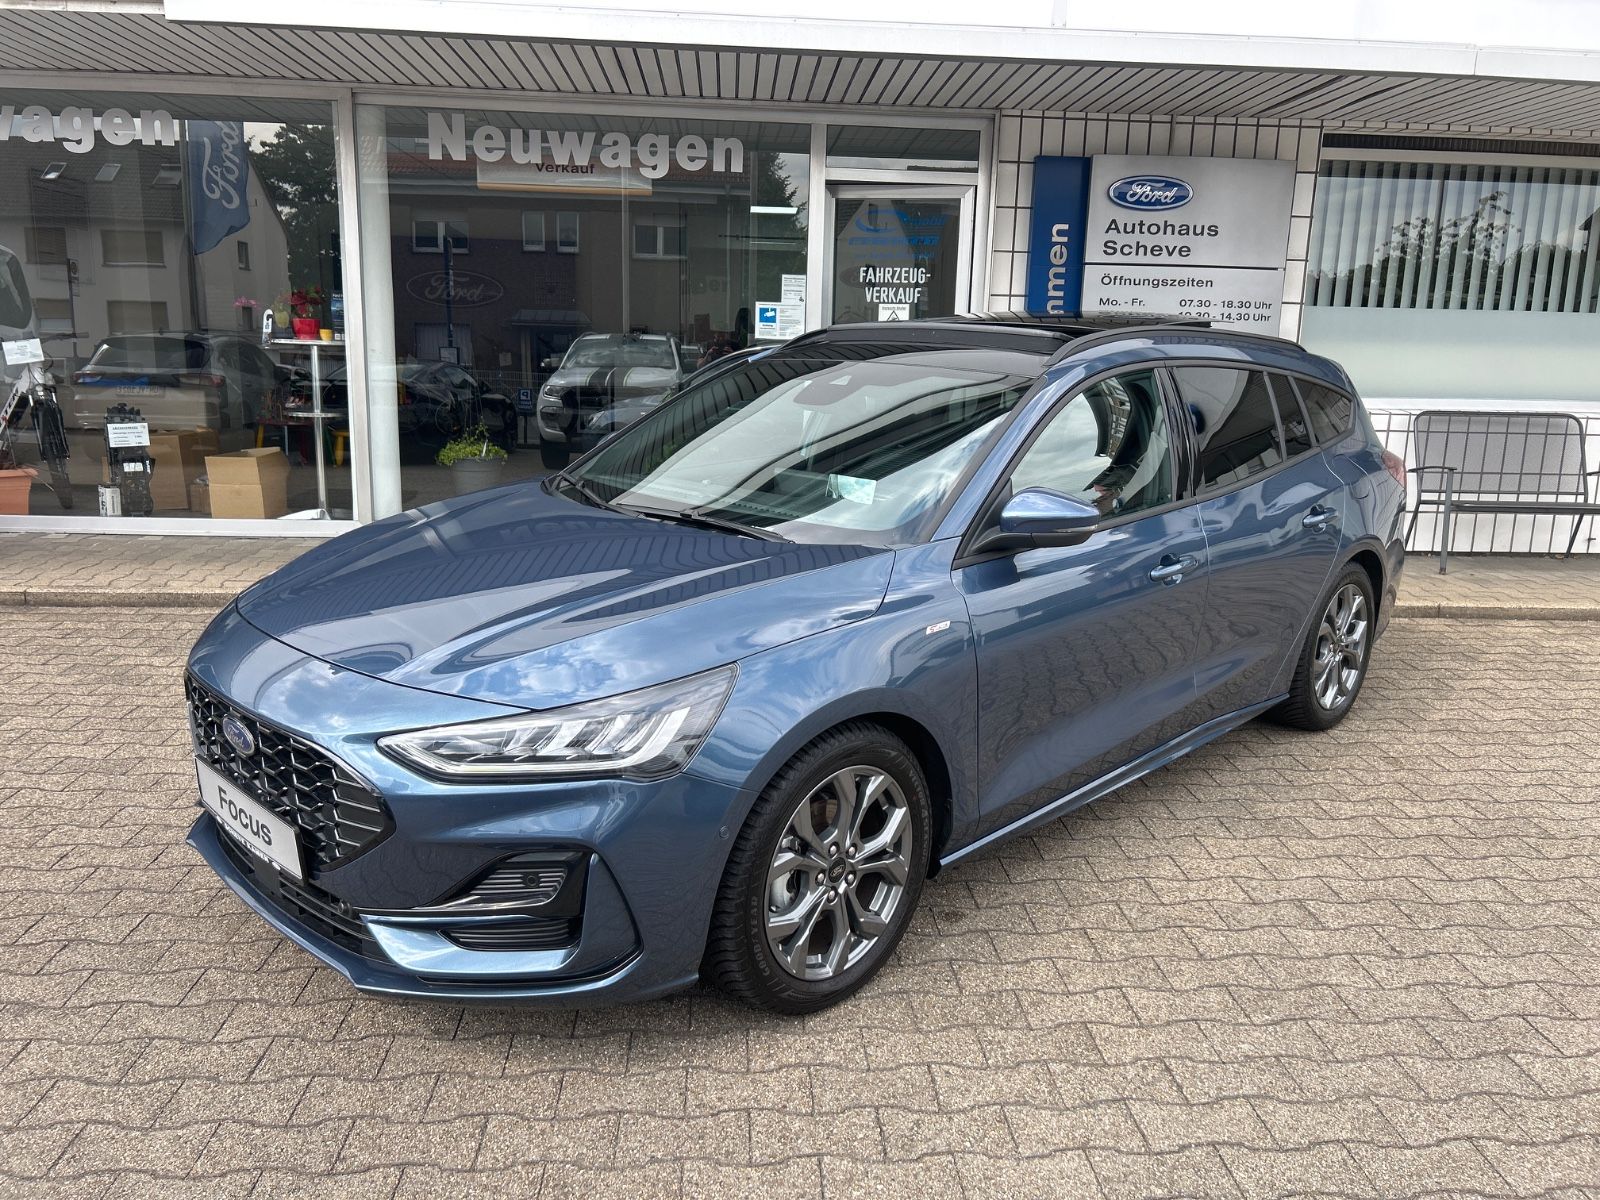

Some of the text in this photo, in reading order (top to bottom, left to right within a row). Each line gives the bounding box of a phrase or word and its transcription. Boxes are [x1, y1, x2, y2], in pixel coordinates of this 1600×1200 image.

[427, 112, 744, 179] Neuwagen
[535, 163, 595, 174] Verkauf
[1126, 181, 1178, 203] Ford
[1105, 219, 1219, 236] Autohaus
[1103, 240, 1191, 257] Scheve
[860, 267, 931, 283] FAHRZEUG-
[1101, 273, 1213, 288] Öffnungszeiten
[865, 287, 921, 303] VERKAUF
[1099, 298, 1121, 306] Mo.
[1132, 298, 1145, 306] Fr.
[1179, 299, 1211, 308] 07.30
[1221, 300, 1252, 309] 18.30
[1254, 301, 1273, 310] Uhr
[1220, 312, 1250, 321] 14.30
[1253, 313, 1271, 322] Uhr
